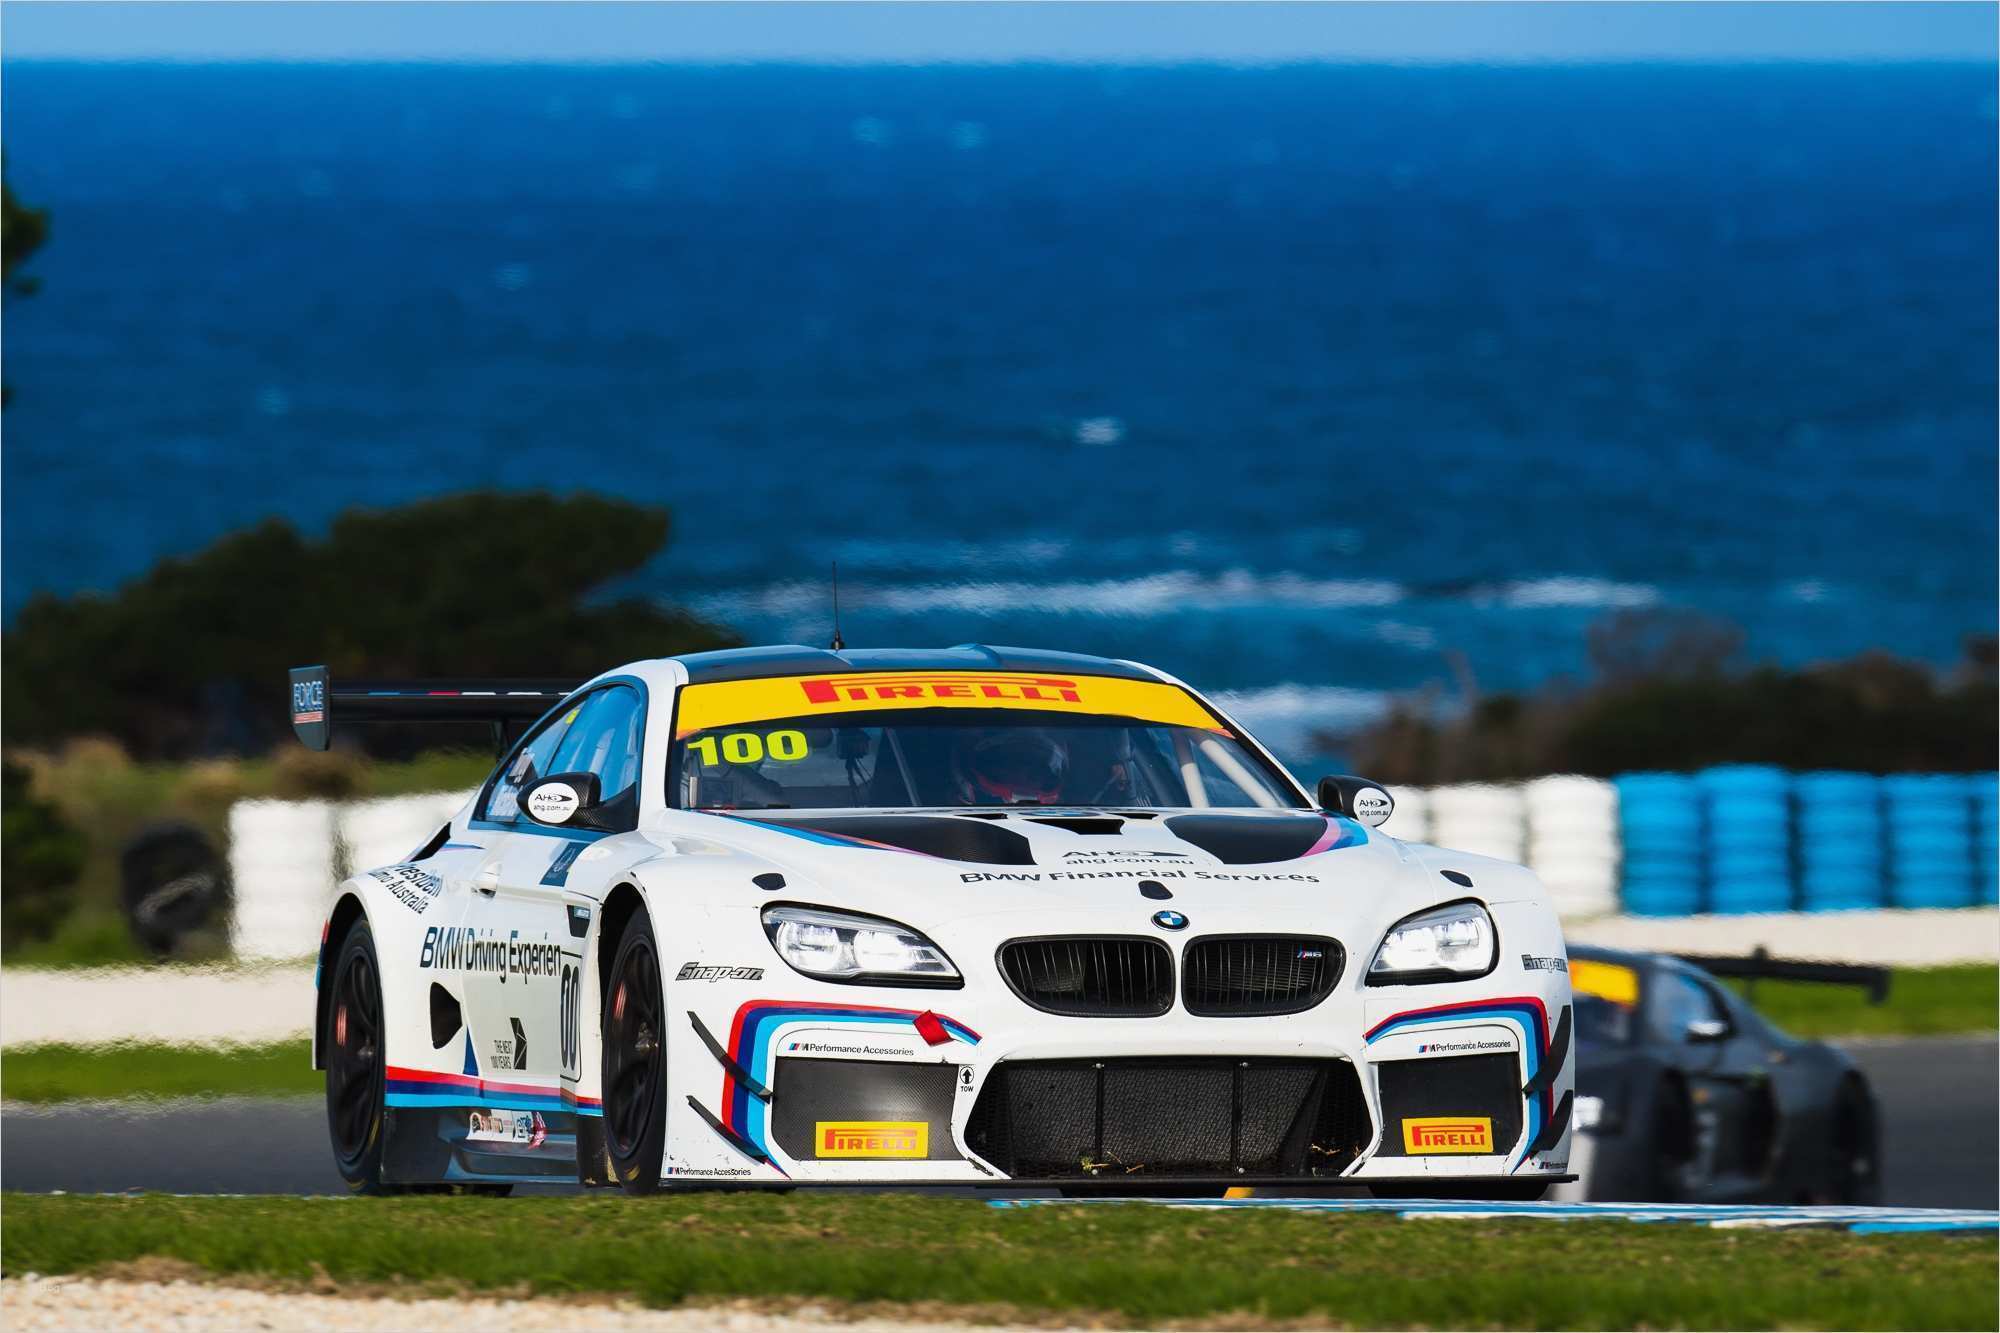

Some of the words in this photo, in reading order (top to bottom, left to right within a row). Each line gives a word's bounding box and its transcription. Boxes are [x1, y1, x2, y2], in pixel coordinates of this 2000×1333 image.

[801, 676, 1081, 705] PIRELLI
[687, 730, 808, 766] 100
[960, 873, 1040, 884] BMW
[1050, 869, 1187, 881] Financial
[1194, 871, 1321, 884] Services
[386, 880, 429, 914] Australia
[420, 926, 465, 970] BMW
[465, 927, 507, 984] Driving
[676, 961, 765, 983] Snap-on
[810, 1043, 862, 1054] Performance
[863, 1046, 915, 1056] Accessories
[1437, 1042, 1476, 1052] Performance
[1477, 1041, 1511, 1049] Accessories
[825, 1129, 918, 1151] PIRELLI
[1411, 1125, 1485, 1147] PIRELLI
[680, 1167, 713, 1176] Performance
[714, 1167, 752, 1176] Accessories
